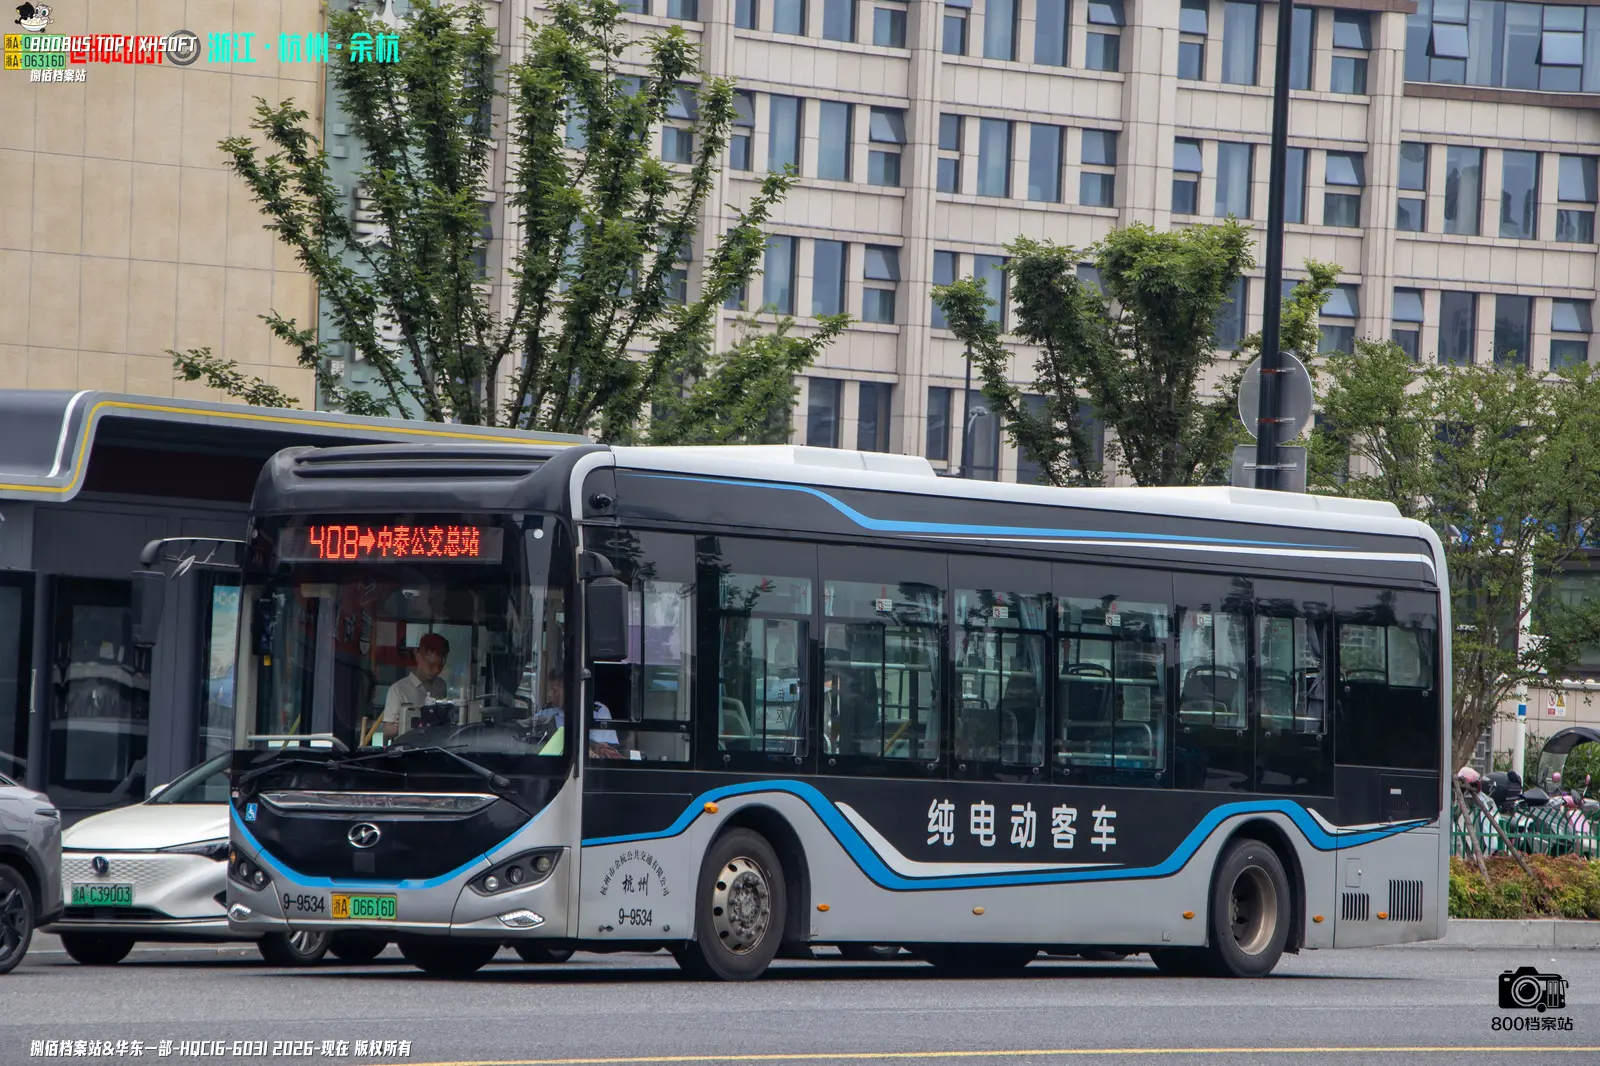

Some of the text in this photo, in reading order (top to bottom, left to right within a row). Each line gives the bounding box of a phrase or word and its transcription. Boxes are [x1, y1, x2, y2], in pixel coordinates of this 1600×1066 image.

[309, 525, 480, 559] 408 中泰公交总站
[926, 798, 1118, 852] 纯电动客车
[622, 872, 650, 896] 杭州
[283, 893, 325, 913] 9-9534
[618, 908, 653, 926] 9-9534
